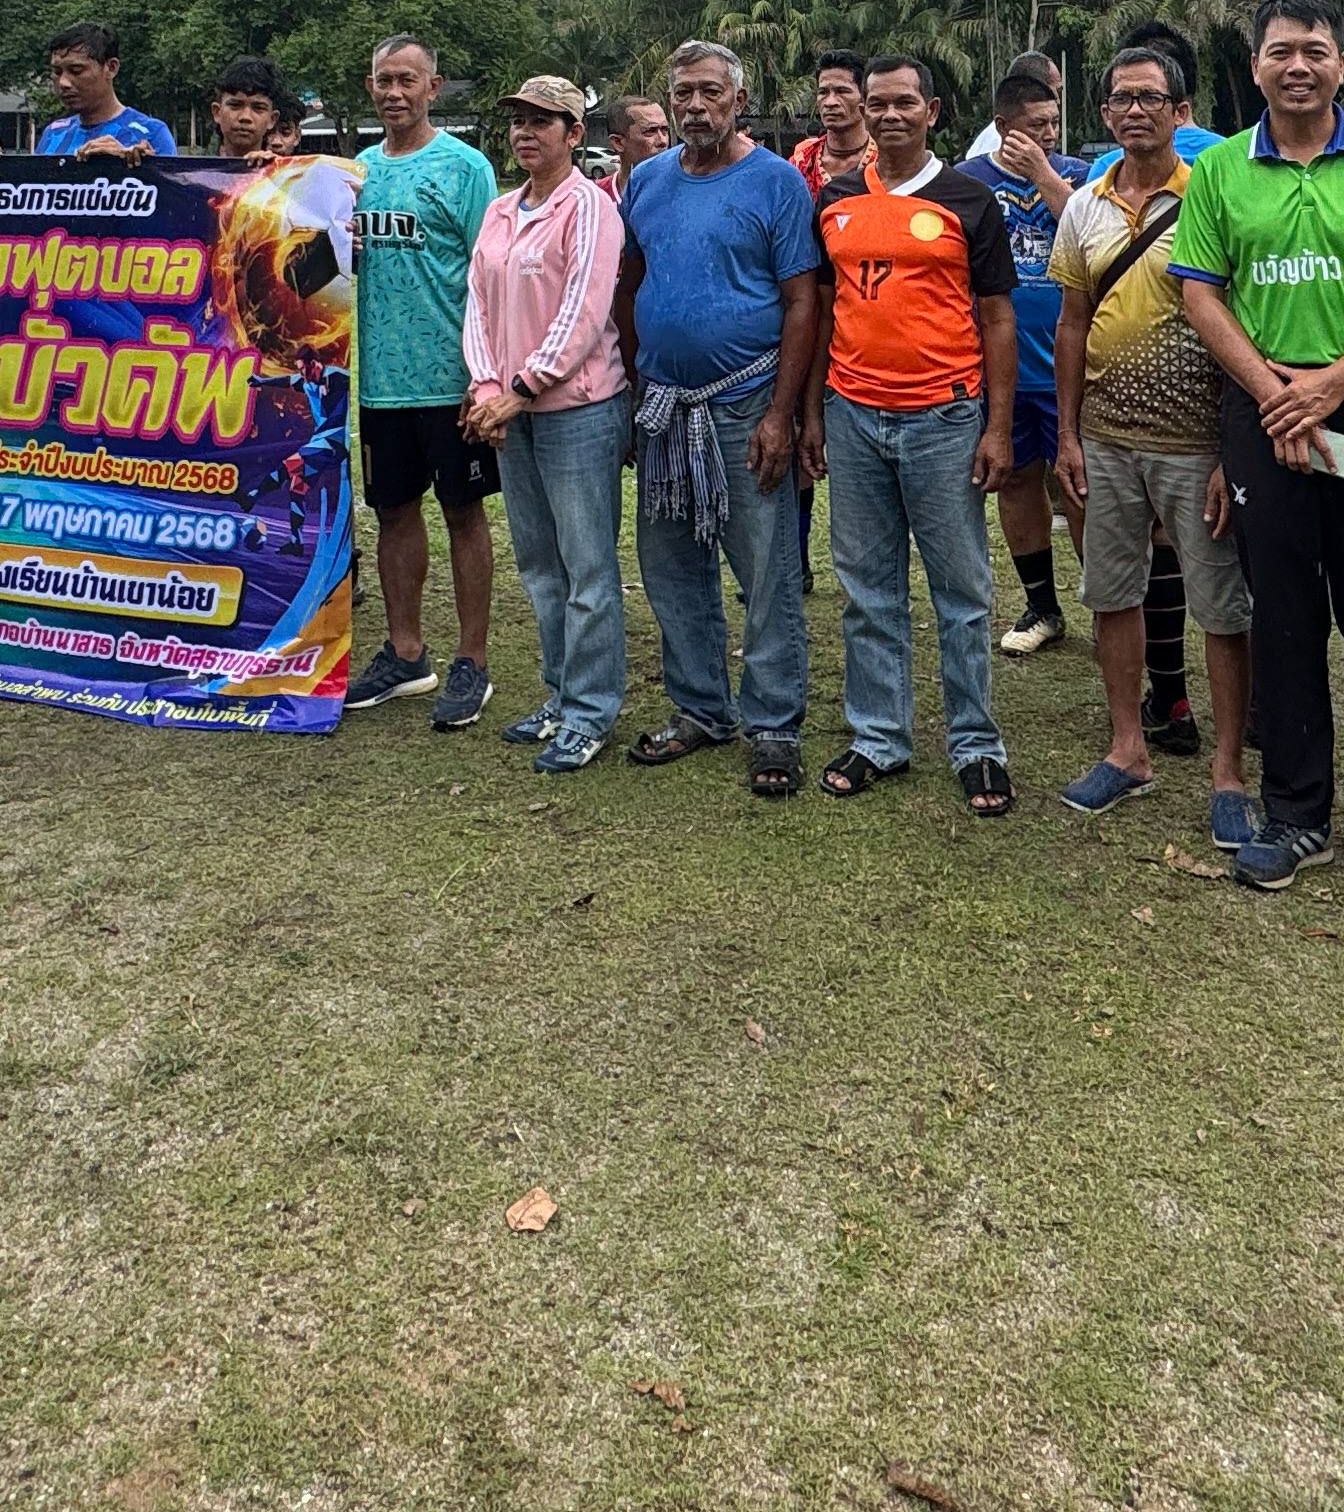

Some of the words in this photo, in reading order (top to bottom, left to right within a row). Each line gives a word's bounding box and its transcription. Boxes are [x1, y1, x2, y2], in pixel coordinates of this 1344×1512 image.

[859, 260, 893, 300] 17
[1251, 248, 1342, 286] ขวัญข้าว
[173, 462, 238, 491] 2568
[23, 501, 153, 543] พฤษภาคม
[157, 516, 236, 550] 2568
